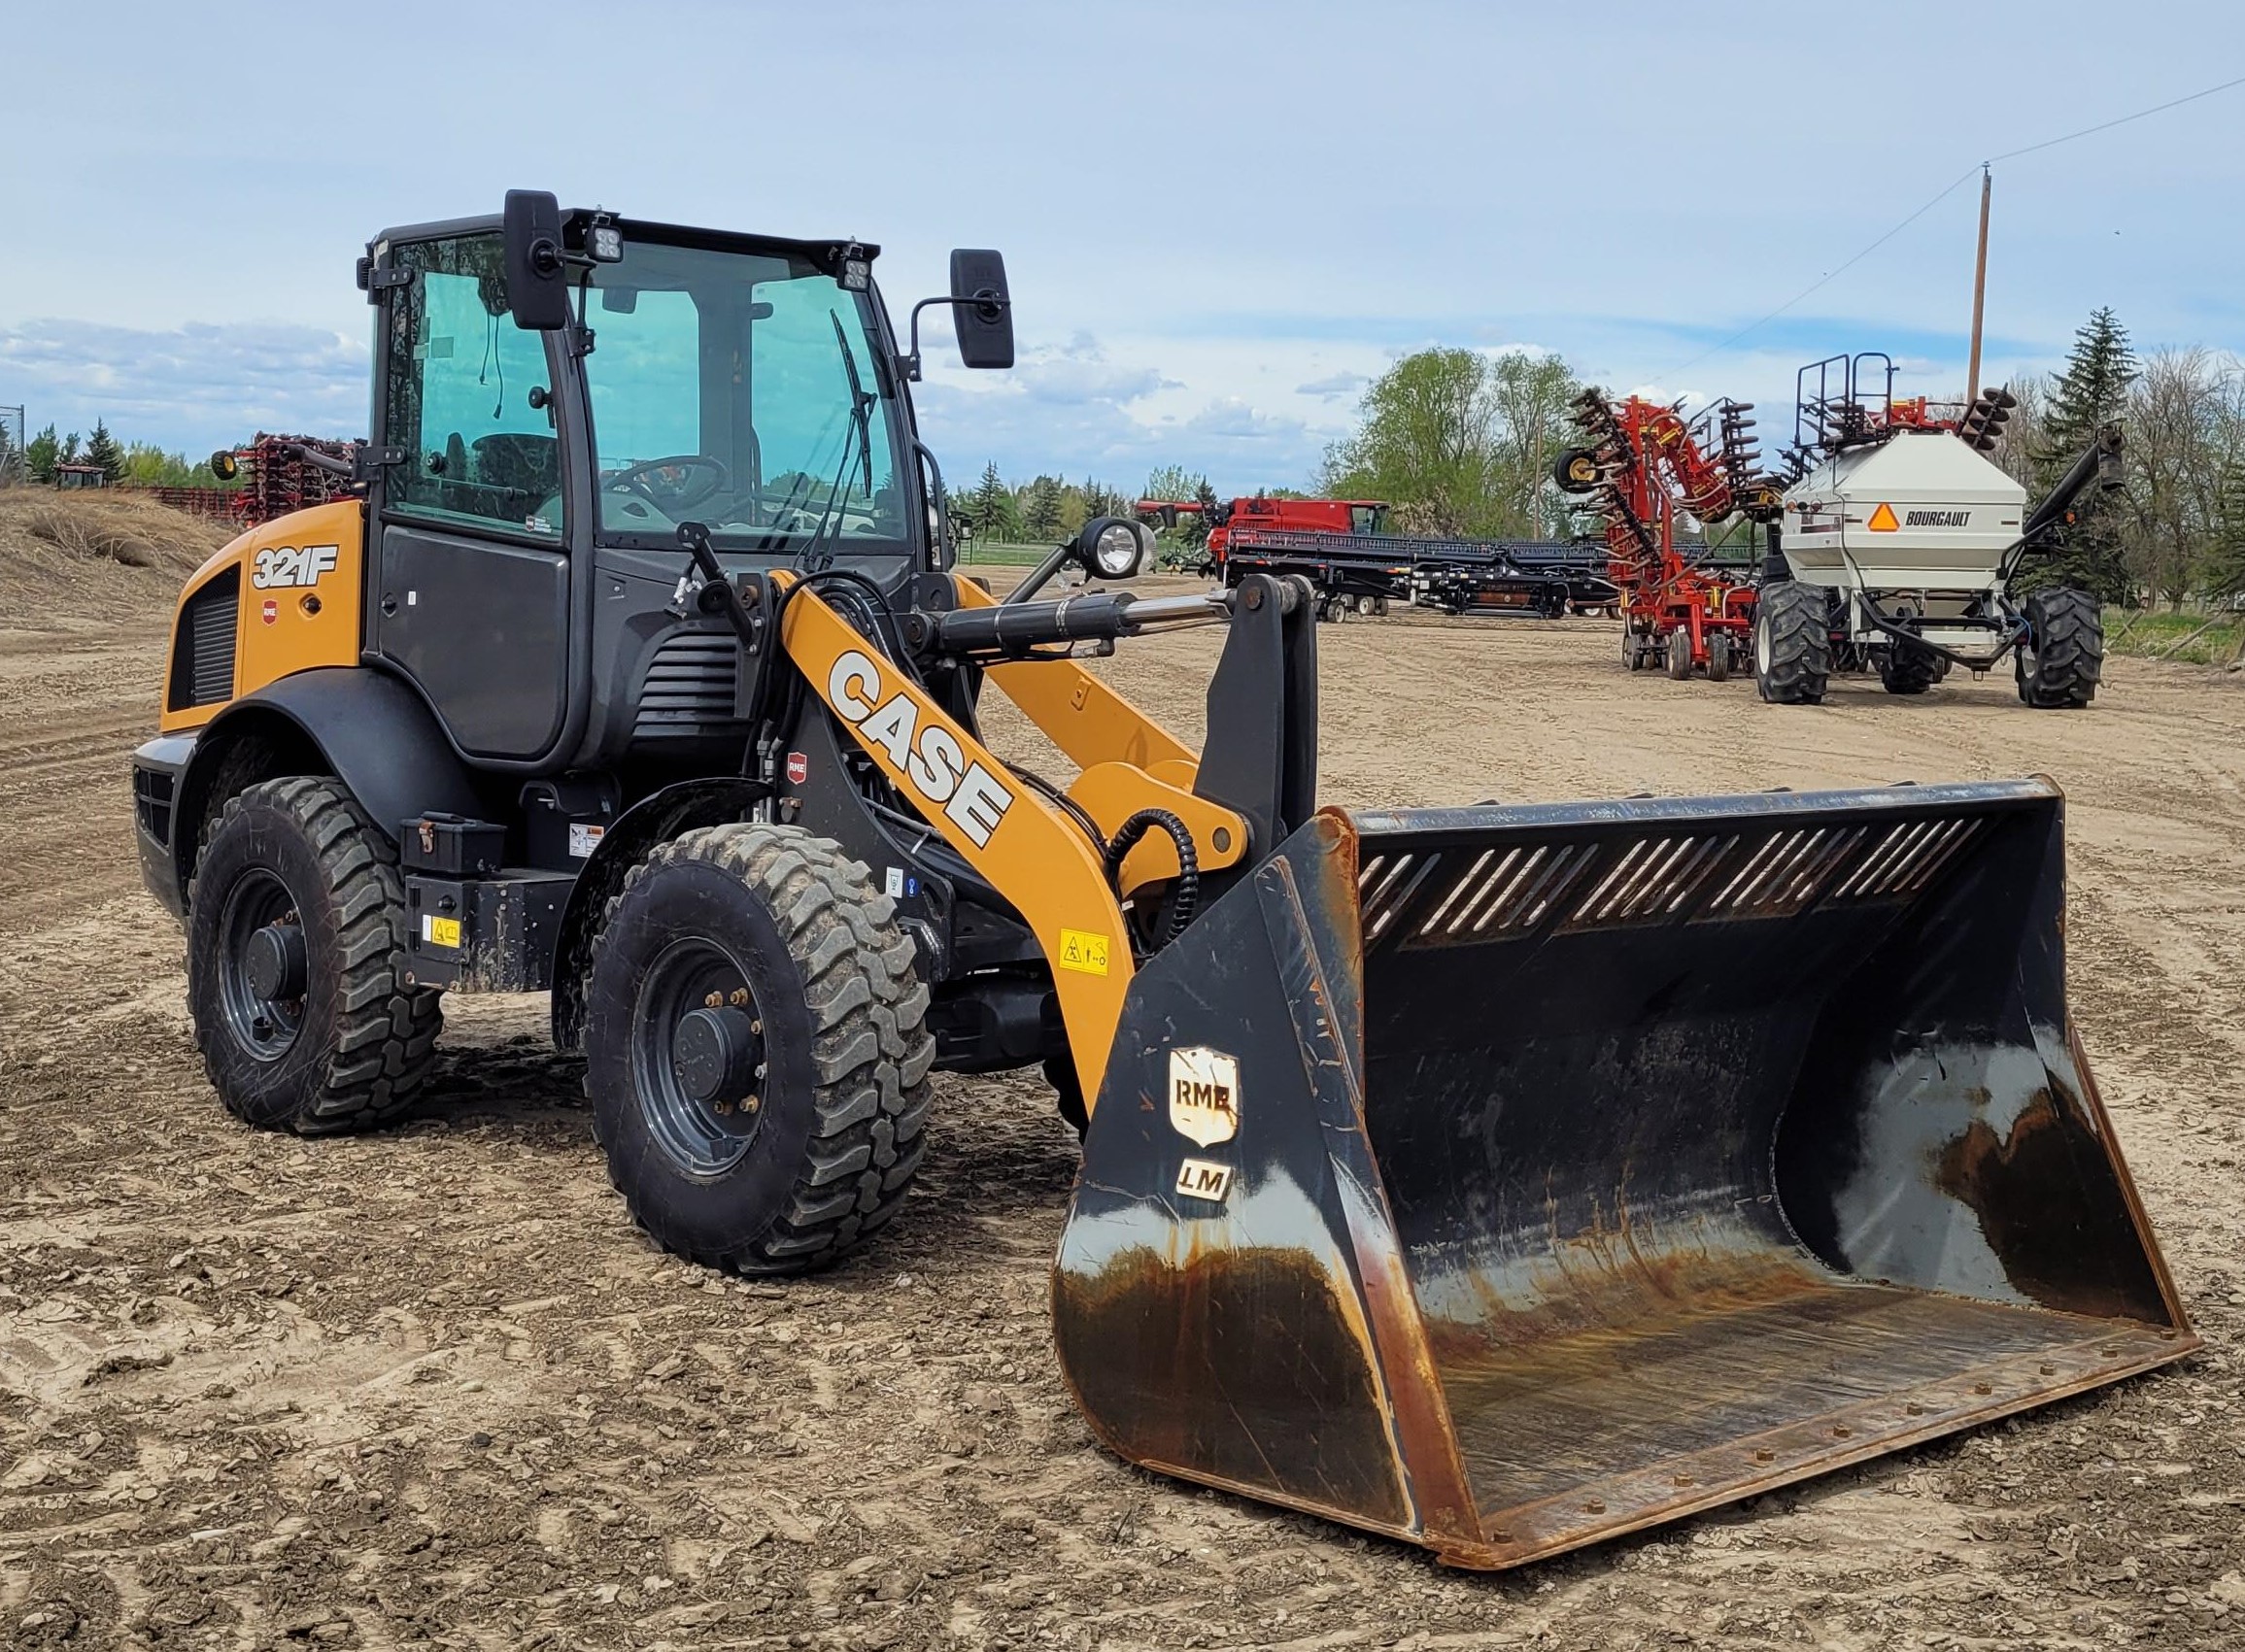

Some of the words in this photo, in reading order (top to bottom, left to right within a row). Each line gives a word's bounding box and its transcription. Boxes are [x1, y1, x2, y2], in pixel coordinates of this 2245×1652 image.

[1905, 511, 1971, 526] BOURGAULT
[253, 544, 339, 590] 321F
[829, 650, 1015, 850] CASE
